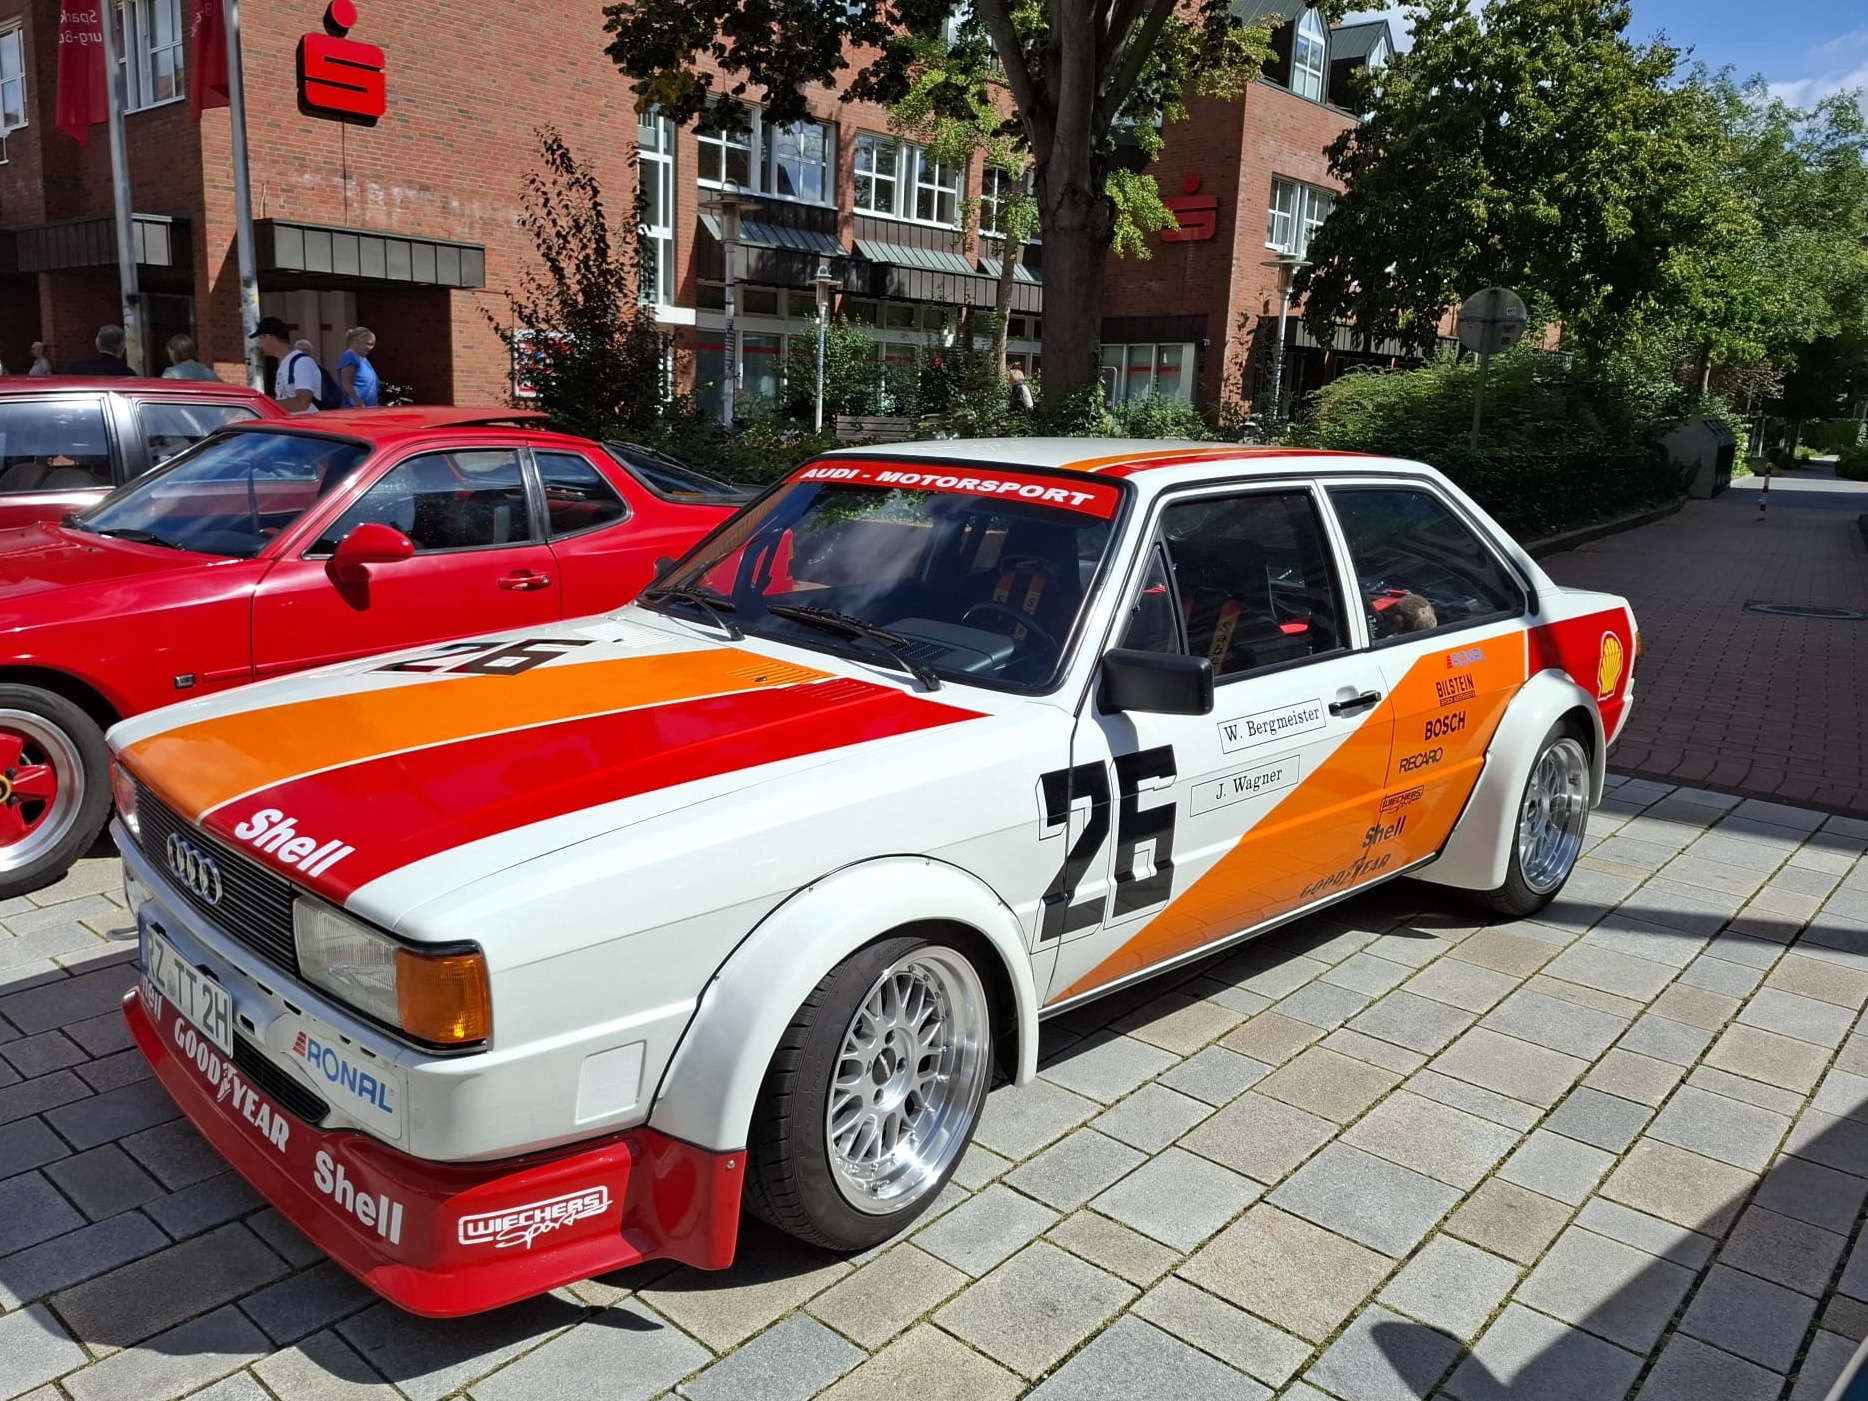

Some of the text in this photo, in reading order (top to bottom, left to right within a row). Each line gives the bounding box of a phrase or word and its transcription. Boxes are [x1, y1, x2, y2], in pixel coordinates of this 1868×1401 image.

[800, 467, 860, 480] AUDI
[876, 471, 1096, 506] MOTORSPORT
[368, 638, 599, 676] 26
[1435, 673, 1475, 698] BILSTEIN
[1223, 708, 1320, 742] W. Bergmeister
[1424, 709, 1466, 741] BOSCH
[1398, 746, 1444, 775] RECARO
[1215, 768, 1283, 800] J. Wagner
[1382, 788, 1423, 809] WIECHERS
[234, 808, 356, 878] Shell
[1037, 743, 1178, 943] 26
[1362, 815, 1408, 848] Shell
[174, 958, 197, 1016] TT
[202, 983, 229, 1047] 2H
[174, 1017, 290, 1154] GOODYEAR
[306, 1037, 394, 1114] RONAL
[313, 1149, 404, 1246] Shell
[466, 1192, 601, 1237] WIECHERS
